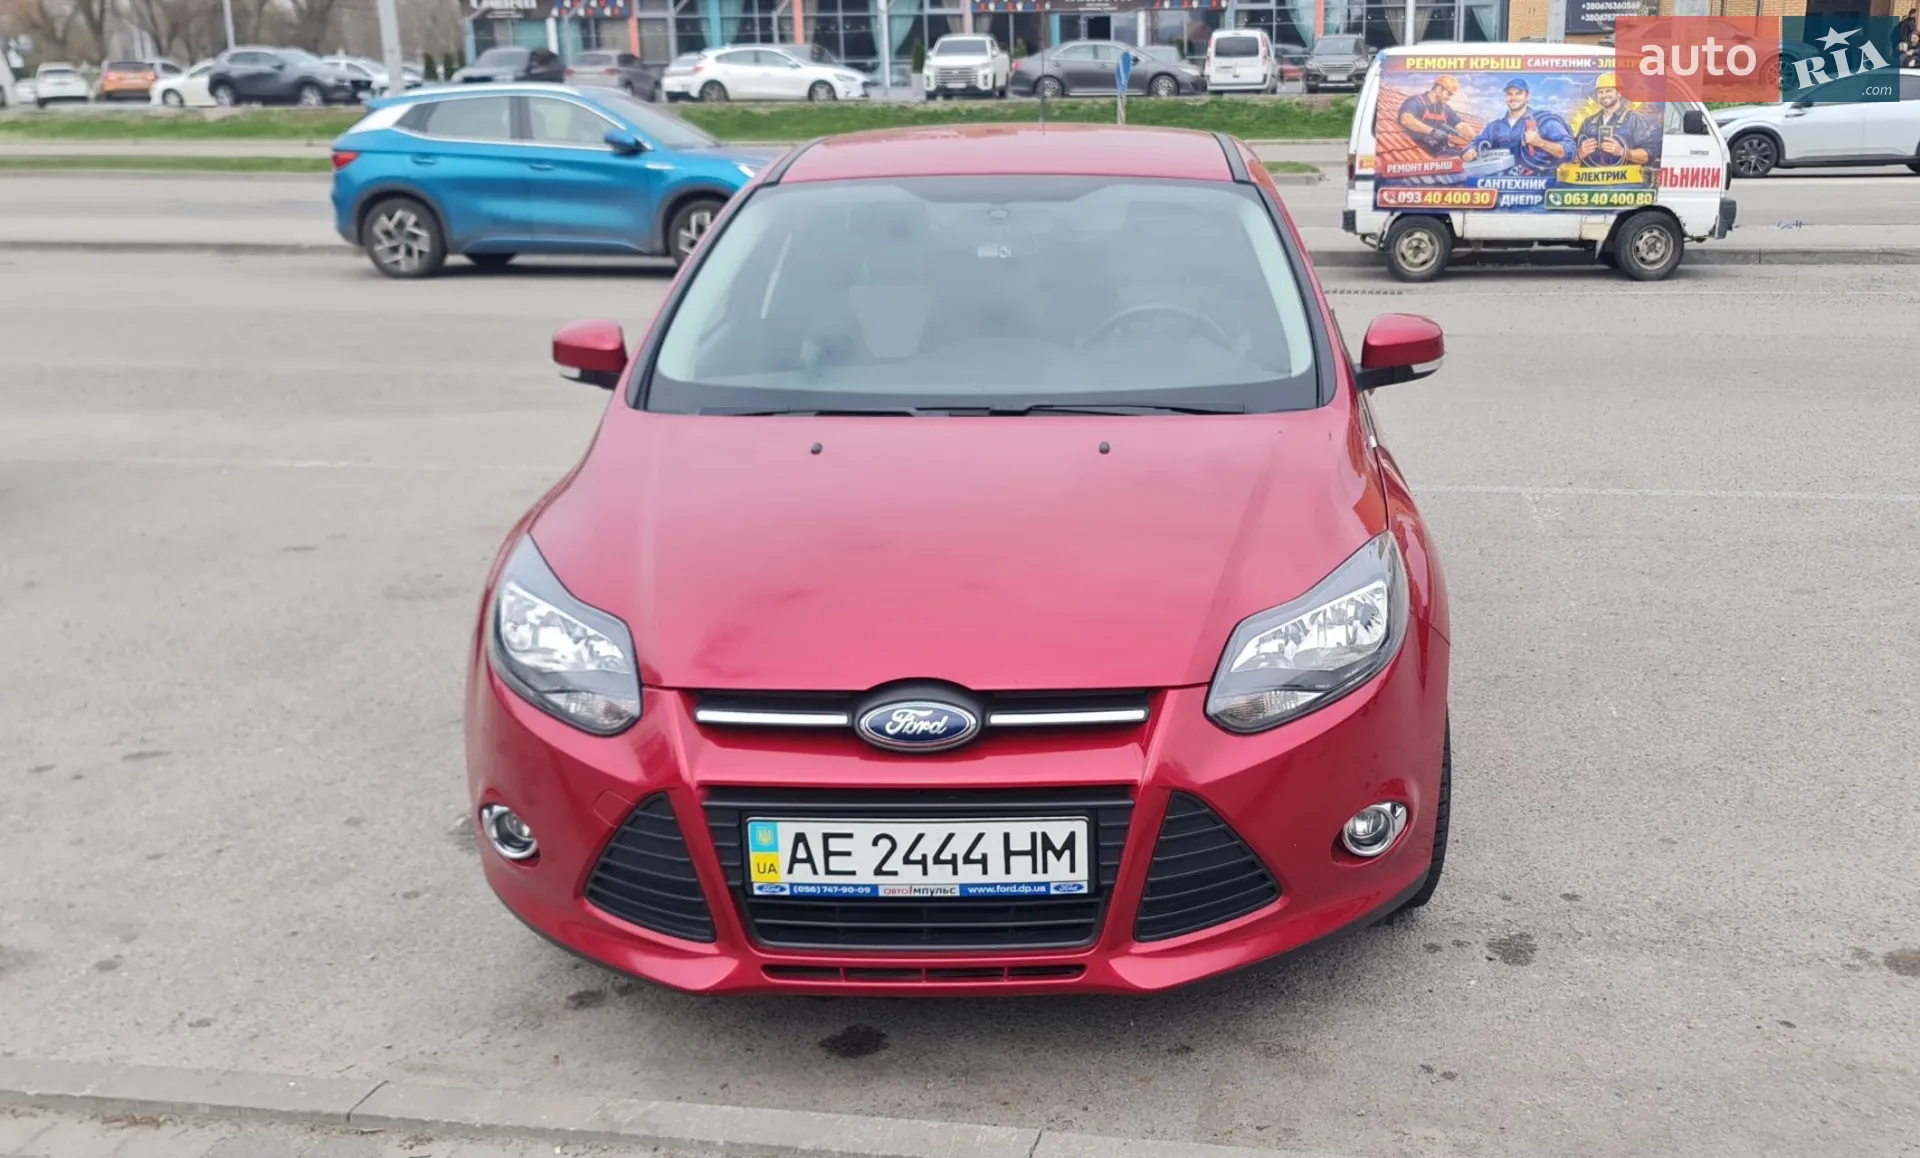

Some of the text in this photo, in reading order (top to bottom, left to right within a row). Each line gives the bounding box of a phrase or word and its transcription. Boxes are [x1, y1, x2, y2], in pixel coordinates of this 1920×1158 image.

[1405, 57, 1522, 70] РЕМОНТ КРЫШ
[1527, 58, 1592, 68] САНТЕХНИК
[1386, 160, 1453, 174] РЕМОНТ КРЫШ
[1575, 169, 1628, 182] ЭЛЕКТРИК
[1476, 178, 1547, 190] САНТЕХНИК
[1397, 192, 1490, 204] 093 40 400 30
[1500, 194, 1543, 207] ДНЕПР
[1564, 193, 1652, 205] 063 40 400 80
[884, 708, 949, 735] Ford
[787, 830, 1077, 876] AE 2444 HM
[756, 862, 778, 875] UA
[823, 886, 871, 894] 747-90-09
[968, 884, 1046, 894] www.ford.dp.ua
